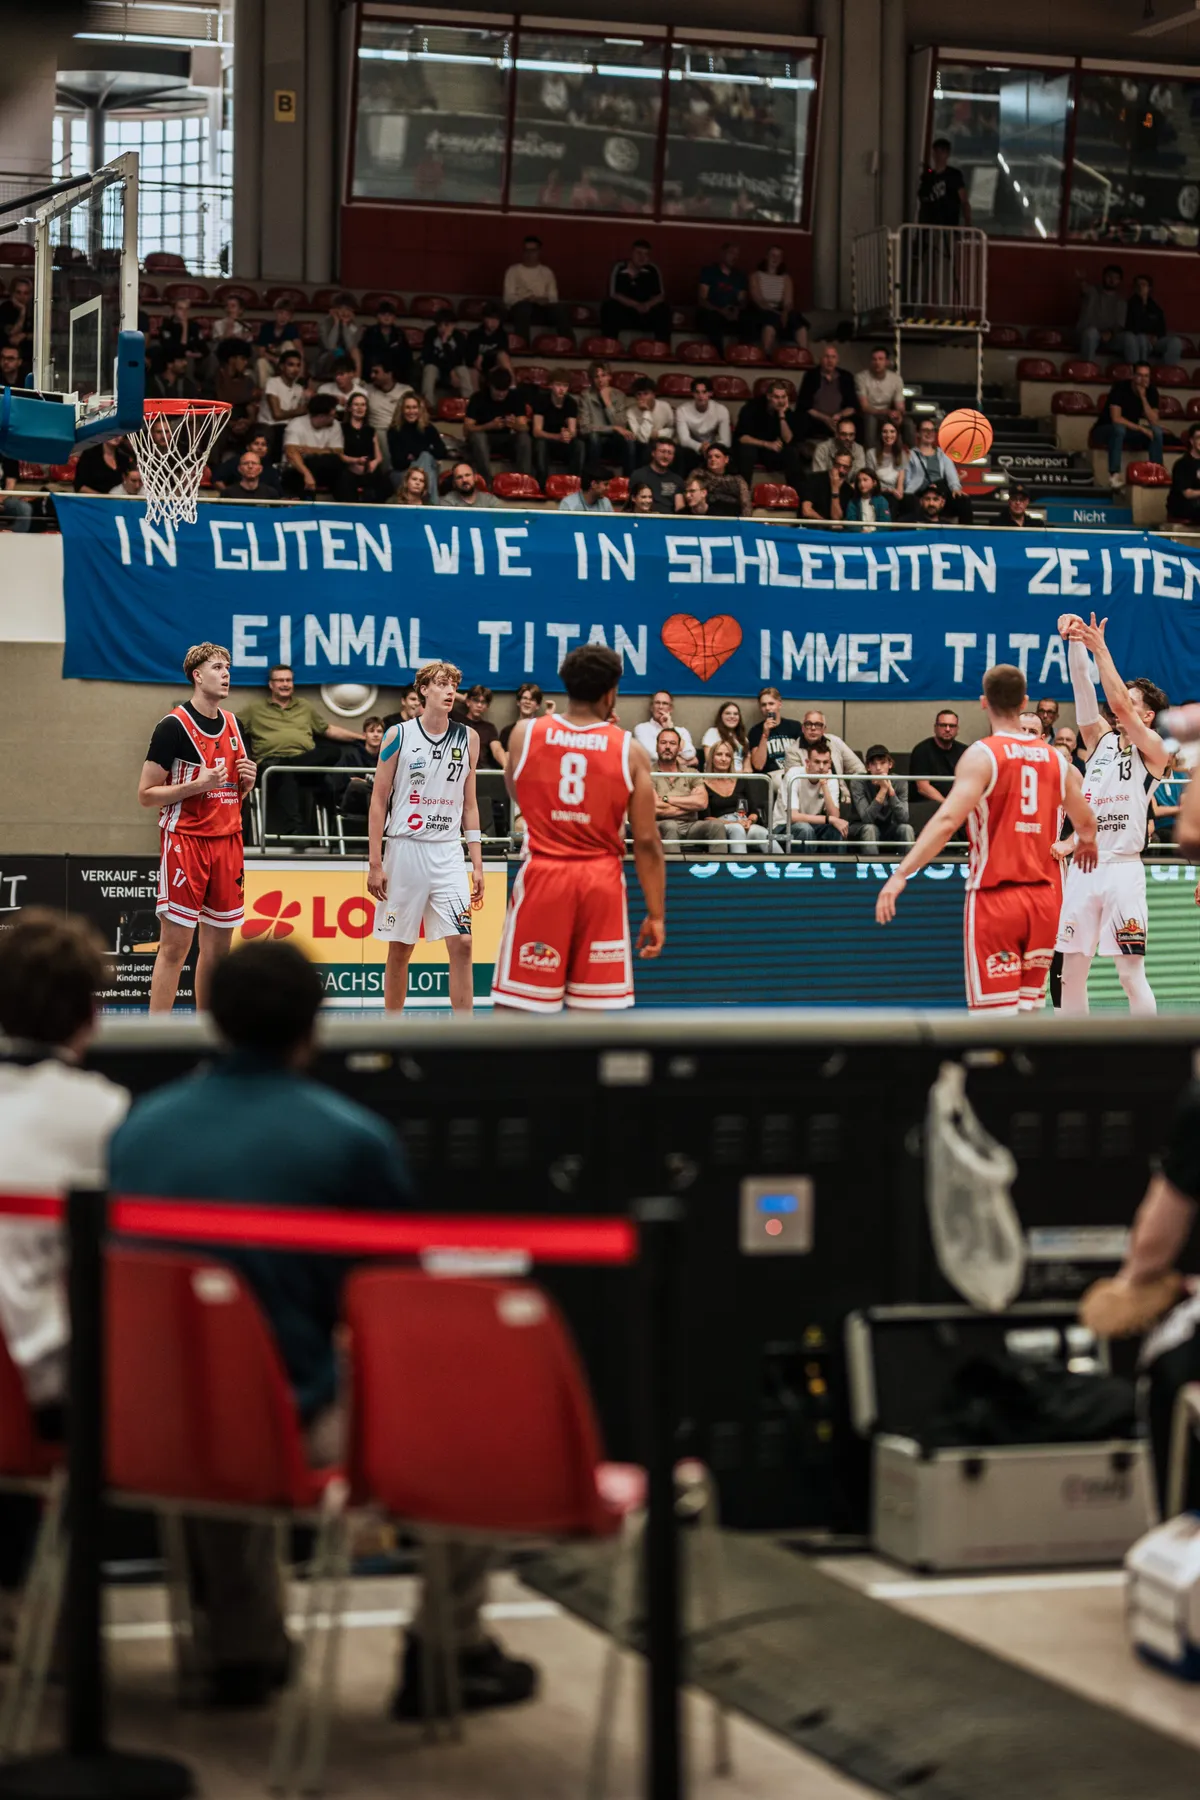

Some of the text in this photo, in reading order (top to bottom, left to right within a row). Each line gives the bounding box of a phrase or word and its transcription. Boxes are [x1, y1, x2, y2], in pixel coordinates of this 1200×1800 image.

[278, 94, 292, 112] B
[1015, 455, 1068, 468] cyberport
[1034, 474, 1069, 483] ARENA
[1073, 509, 1106, 523] Nicht
[115, 515, 177, 567] IN
[209, 520, 393, 572] GUTEN
[424, 524, 532, 577] WIE
[574, 532, 636, 581] IN
[665, 535, 997, 593] SCHLECHTEN
[232, 613, 443, 669] EINMAL
[760, 628, 913, 684] IMMER
[446, 762, 464, 783] 27
[558, 751, 588, 806] 8
[1117, 760, 1133, 782] 13
[1020, 764, 1038, 816] 9
[81, 870, 138, 882] VERKAUF
[172, 868, 187, 888] 17
[115, 963, 133, 972] wird
[133, 963, 153, 973] jeder
